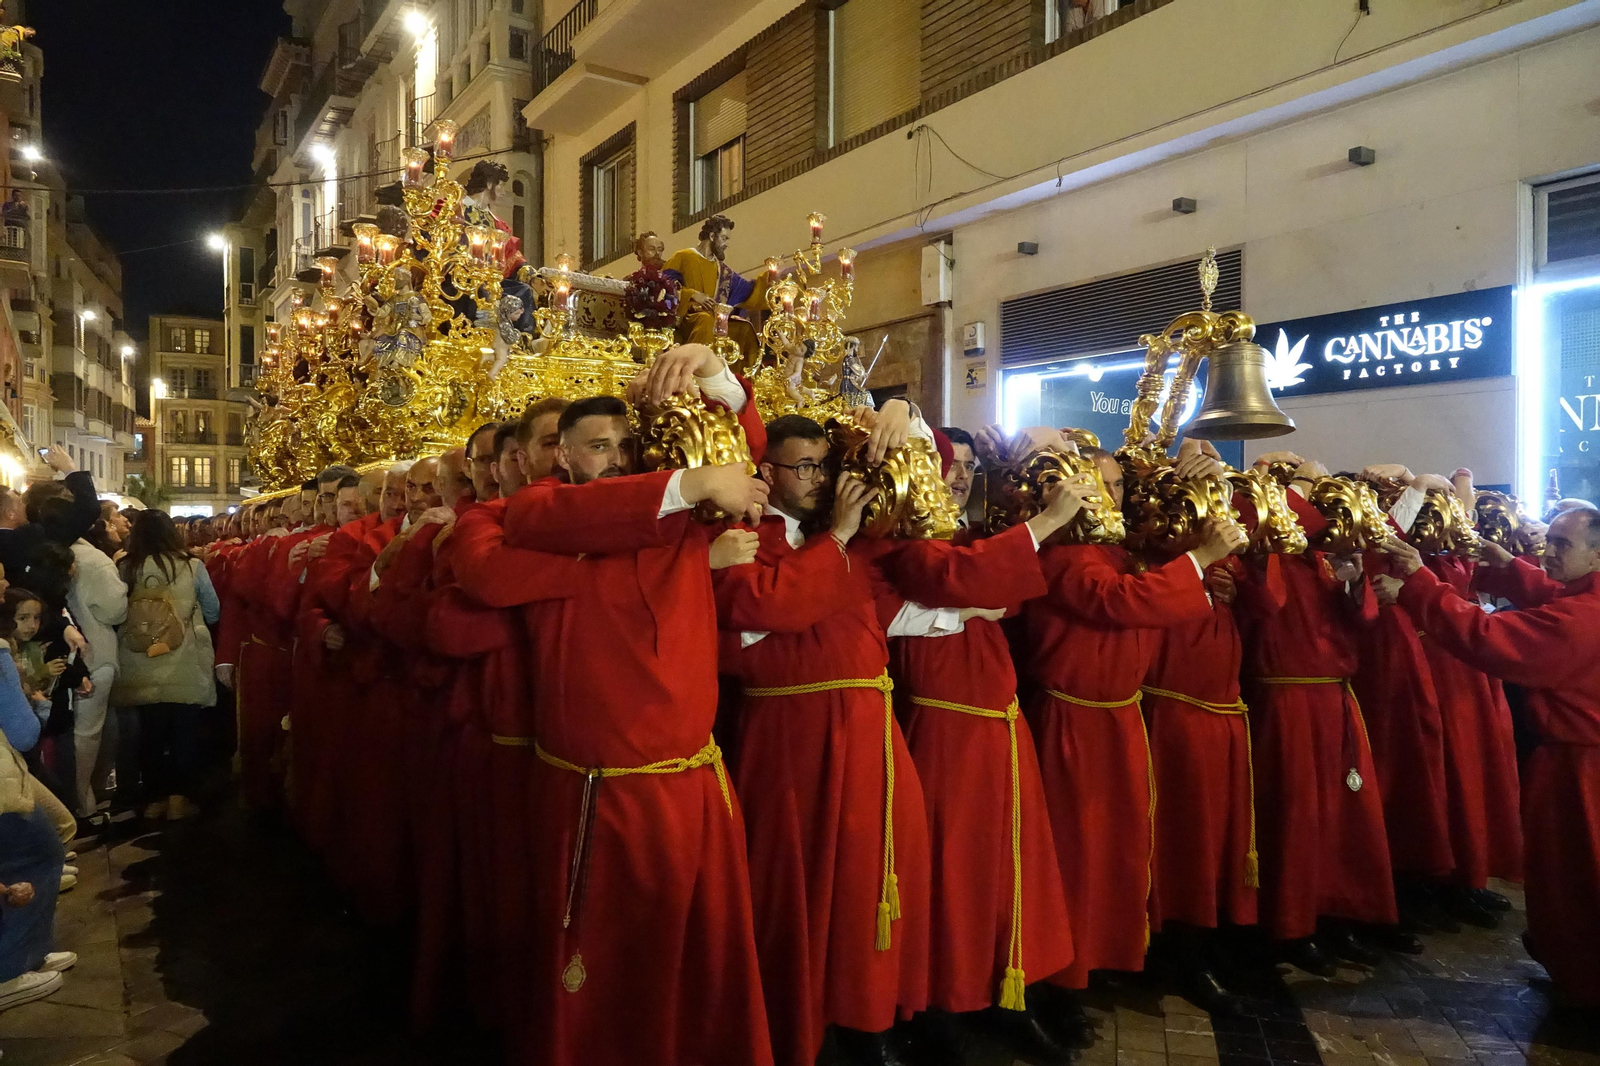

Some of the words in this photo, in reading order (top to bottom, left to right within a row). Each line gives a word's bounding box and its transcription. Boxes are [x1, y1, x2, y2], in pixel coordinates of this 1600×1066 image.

[1379, 311, 1420, 327] THE
[1343, 357, 1460, 380] FACTORY
[1090, 391, 1119, 414] You
